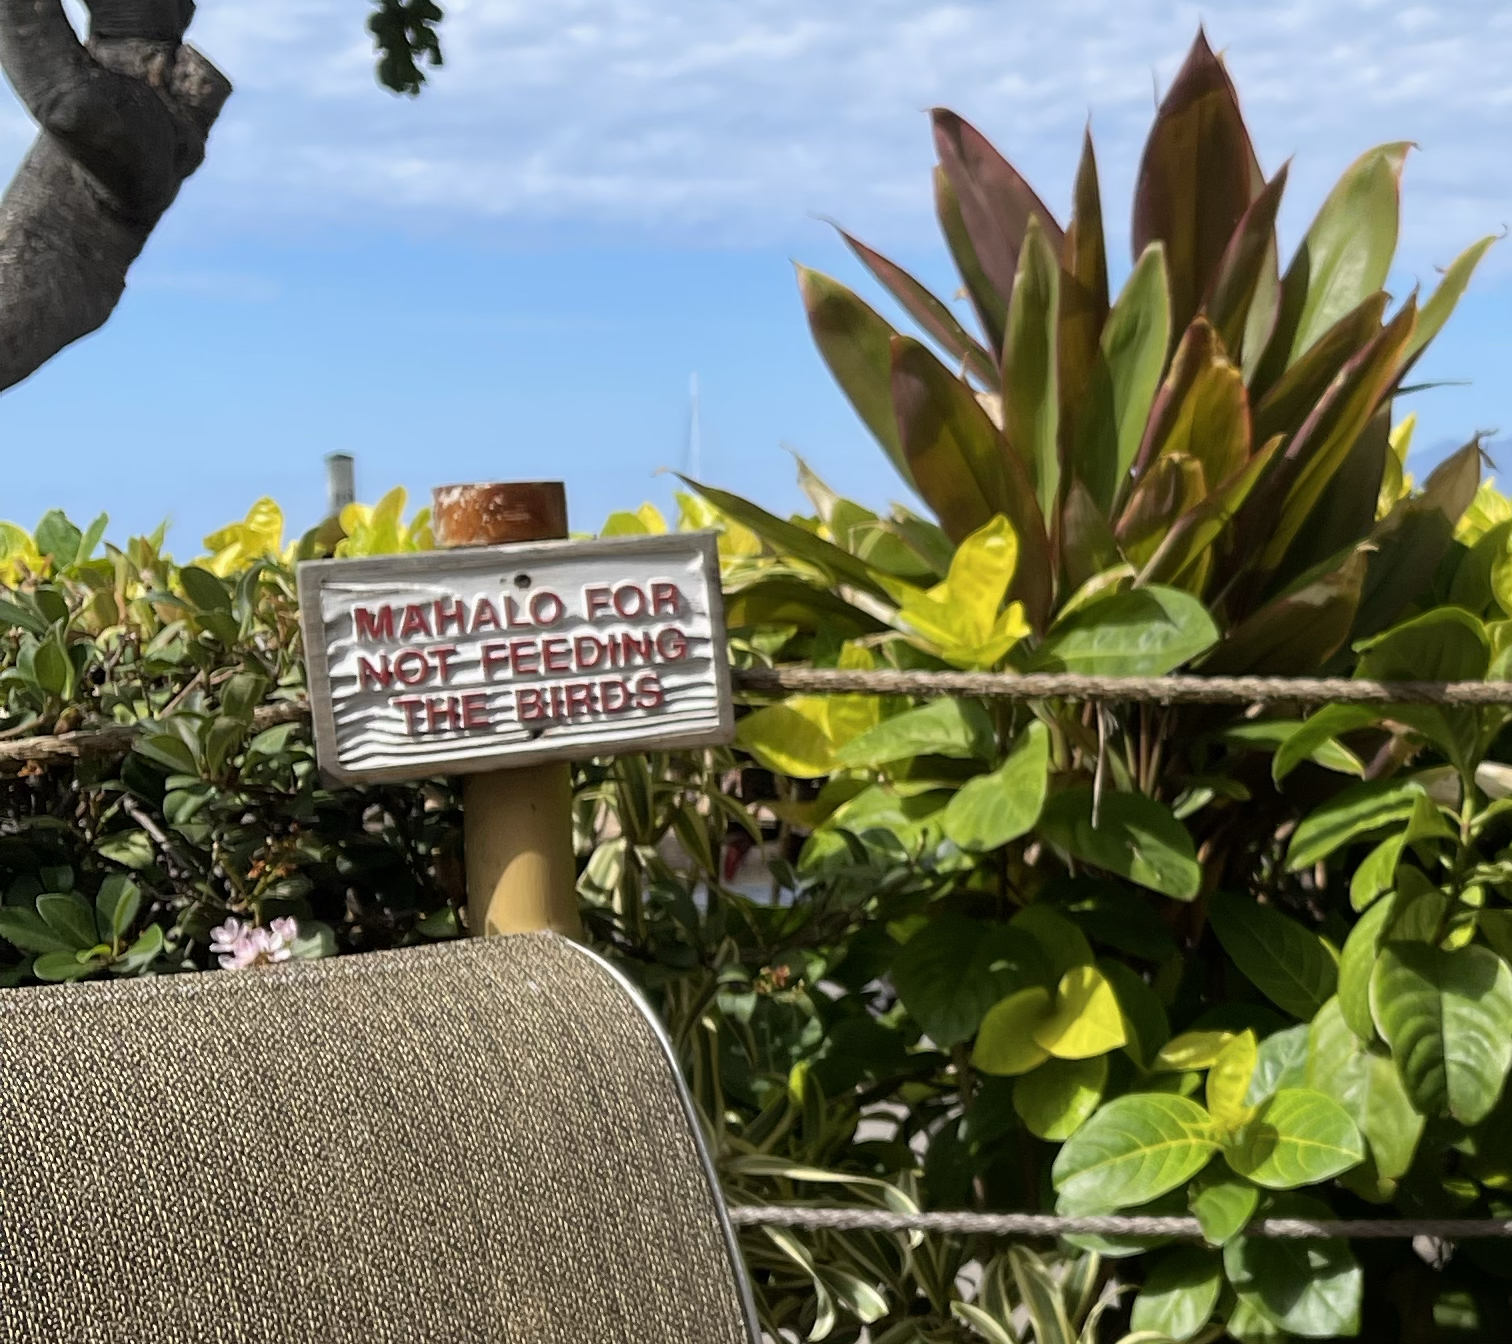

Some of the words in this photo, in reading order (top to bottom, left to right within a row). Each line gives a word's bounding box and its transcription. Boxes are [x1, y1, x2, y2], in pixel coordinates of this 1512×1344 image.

[354, 587, 564, 643] MAHALO
[584, 579, 680, 621] FOR
[357, 644, 457, 689] NOT
[481, 626, 688, 681] FEEDING
[391, 691, 491, 736] THE
[514, 671, 665, 722] BIRDS
